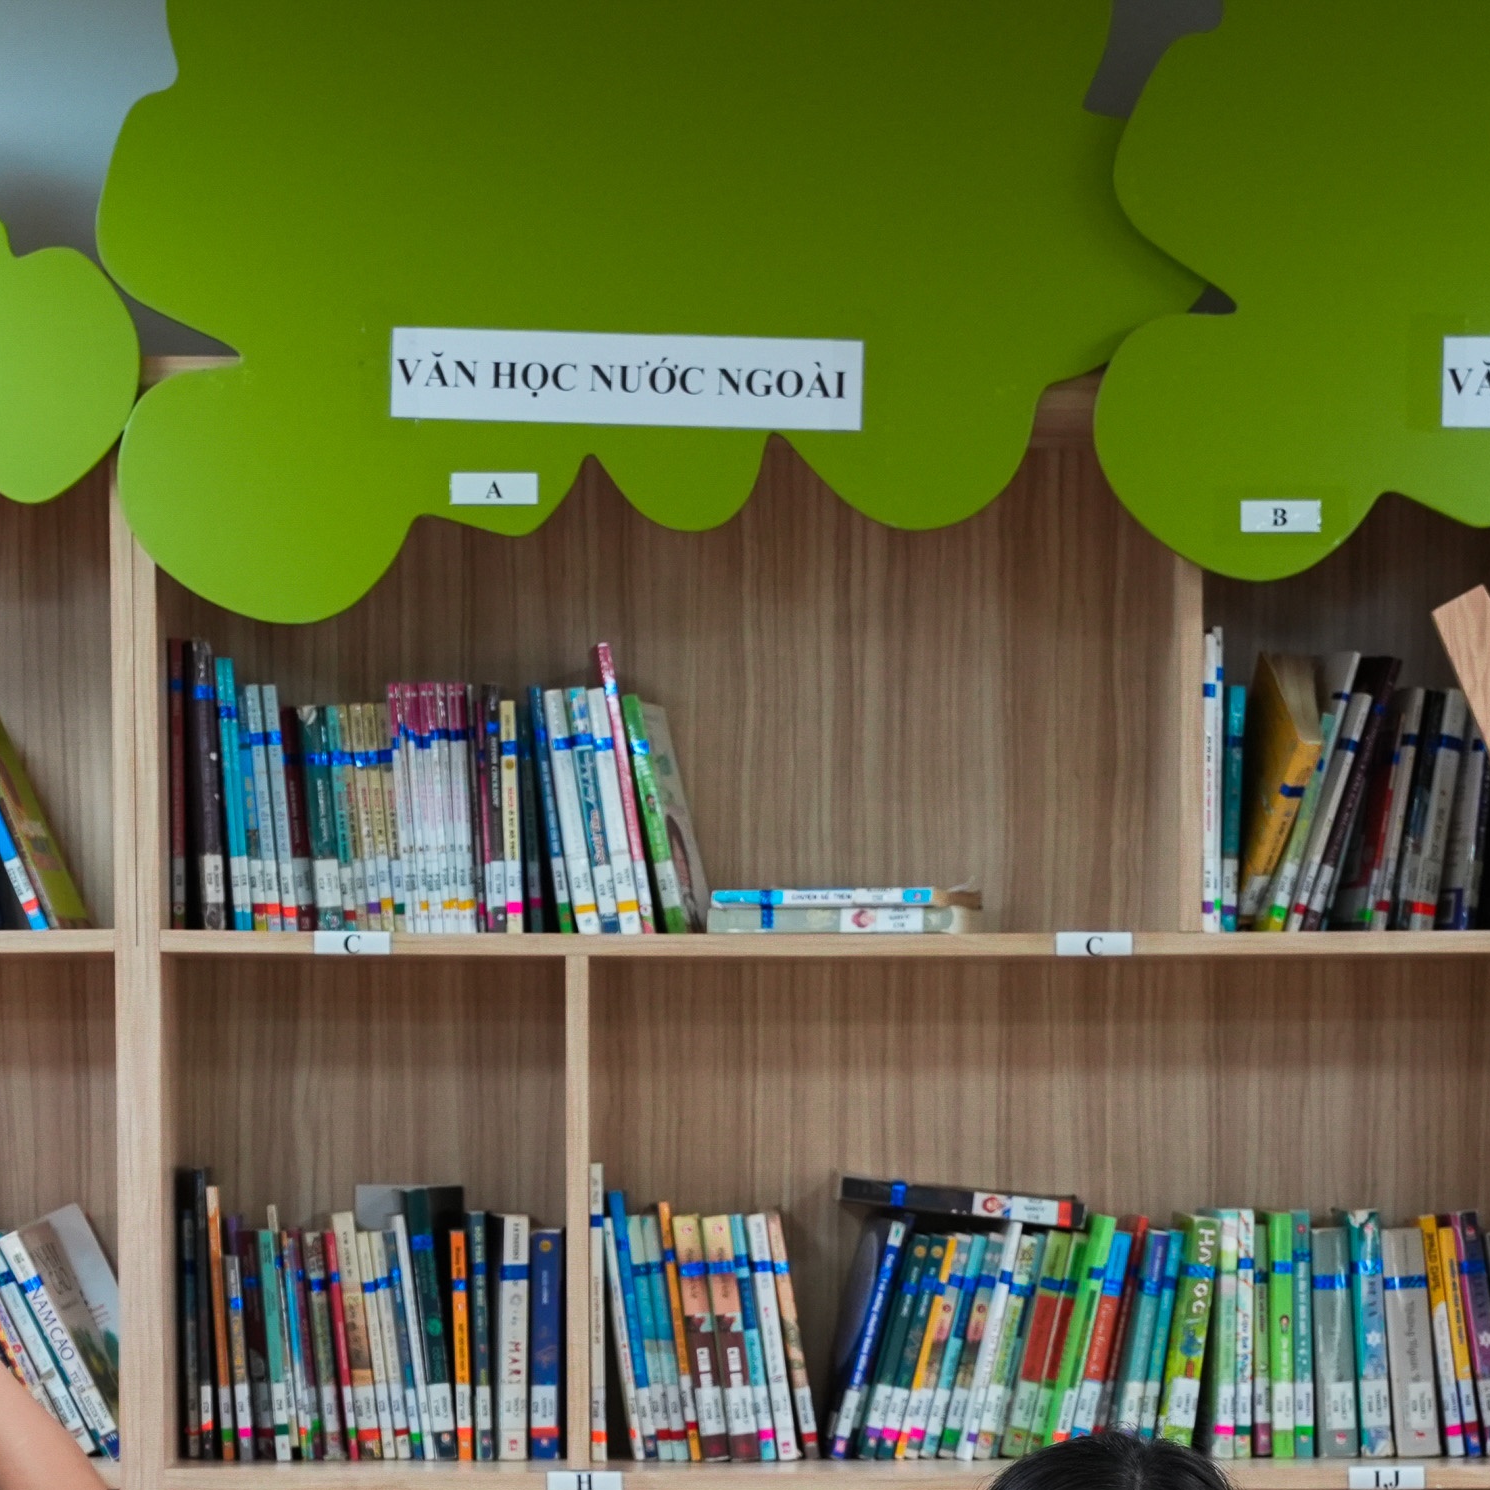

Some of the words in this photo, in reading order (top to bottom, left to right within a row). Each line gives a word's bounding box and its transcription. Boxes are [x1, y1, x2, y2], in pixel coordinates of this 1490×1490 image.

[398, 350, 477, 389] VĂN
[492, 360, 577, 400] HỌC
[590, 356, 706, 396] NƯỚC
[718, 358, 847, 398] NGOÀI
[485, 480, 503, 500] A
[1271, 508, 1288, 528] B
[343, 934, 360, 954] C
[1086, 936, 1105, 956] C
